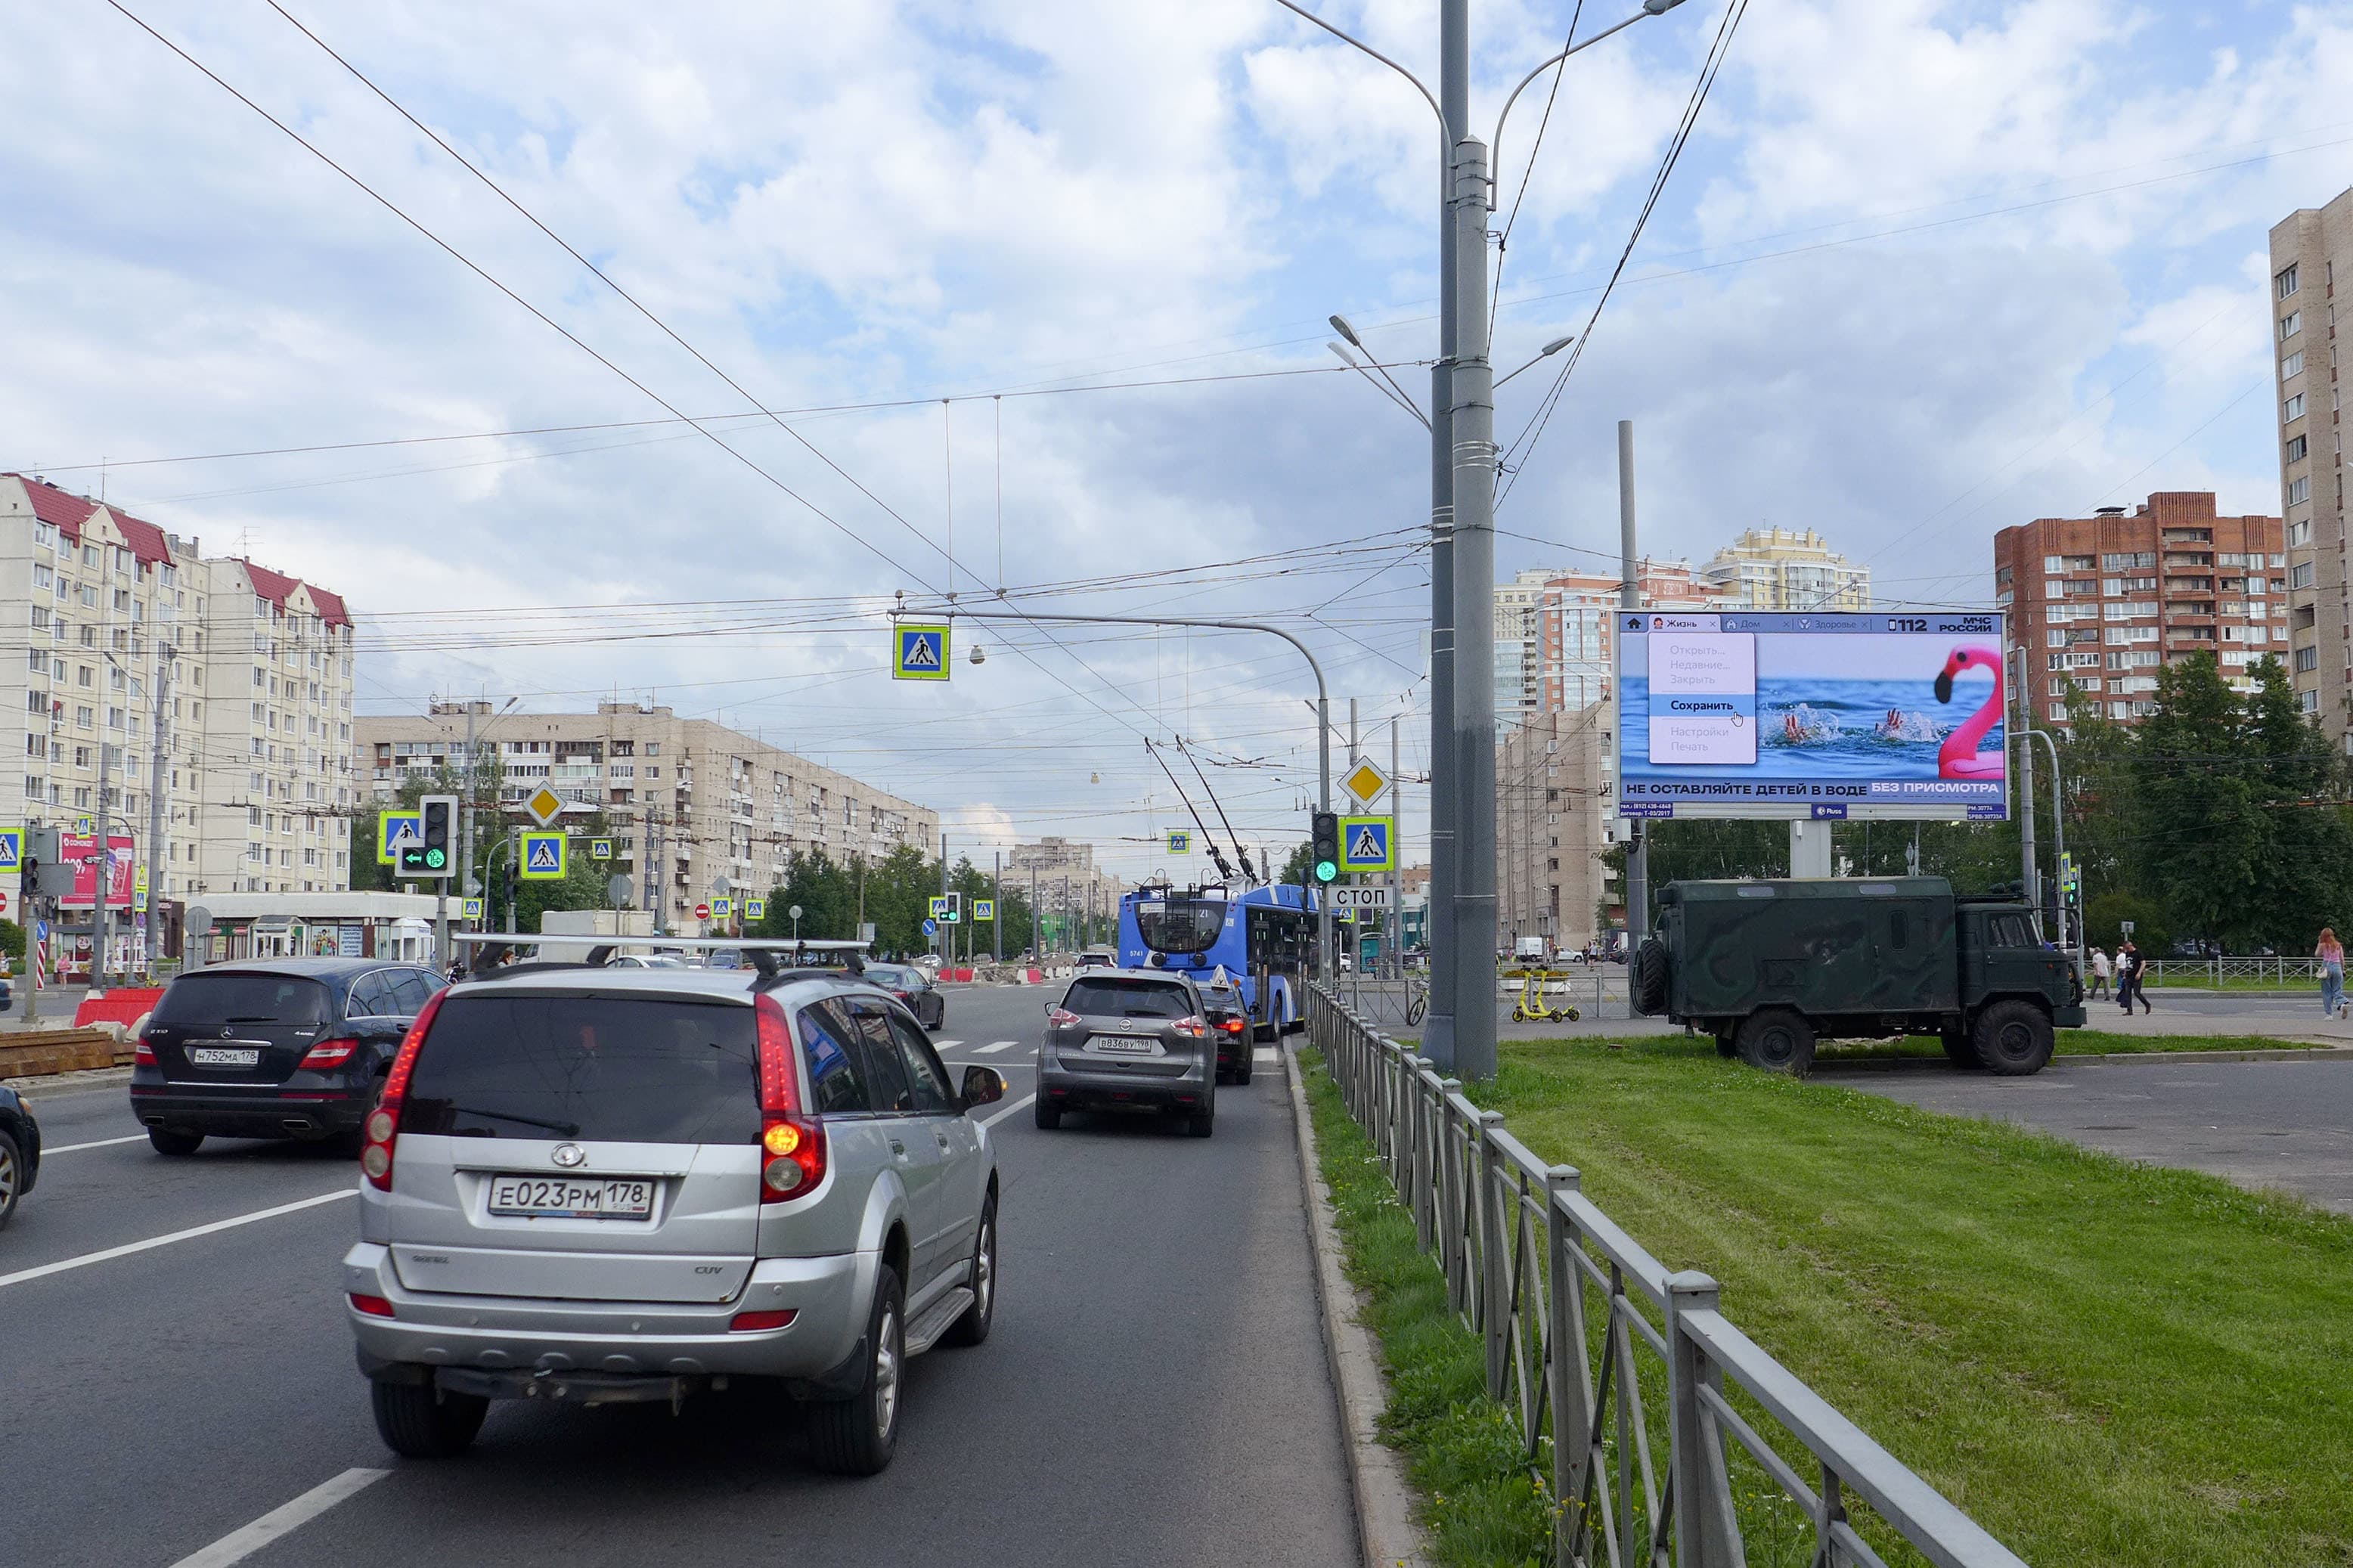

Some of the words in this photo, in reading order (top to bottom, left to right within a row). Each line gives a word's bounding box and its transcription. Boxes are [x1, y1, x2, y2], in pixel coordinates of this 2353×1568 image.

[1741, 620, 1760, 629] Дом
[1815, 621, 1857, 630] Здоровье
[1899, 619, 1927, 632] 112
[1669, 645, 1725, 655] Открыть...
[1669, 660, 1731, 671] Недавние...
[1669, 674, 1716, 684] Закрыть
[1670, 700, 1734, 712] Сохранить
[1670, 727, 1729, 738] Настройки
[1670, 742, 1709, 751] Печать
[1626, 784, 1646, 794] НЕ
[1650, 782, 1752, 795] ОСТАВЛЯЙТЕ
[1755, 782, 1807, 796] ДЕТЕЙ
[1811, 786, 1821, 795] В
[1825, 786, 1868, 796] ВОДЕ
[1871, 782, 1900, 792] БЕЗ
[1904, 782, 1999, 793] ПРИСМОТРА
[1337, 890, 1384, 904] СТОП
[1199, 909, 1208, 919] 21
[606, 1182, 643, 1203] 178
[695, 1266, 724, 1275] CUV
